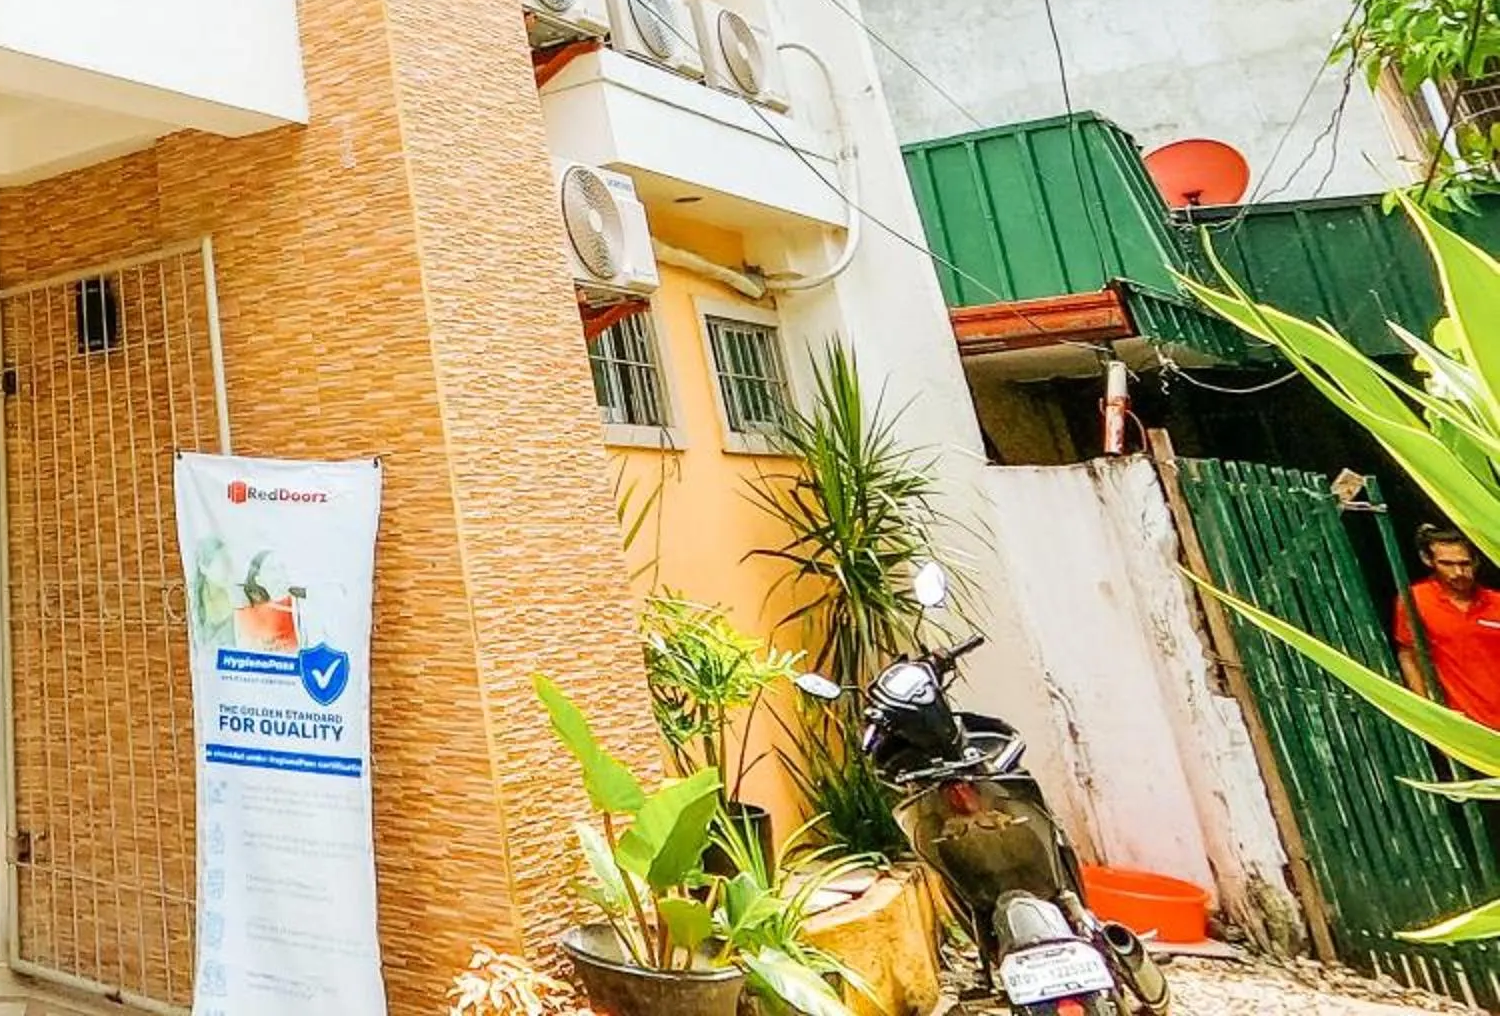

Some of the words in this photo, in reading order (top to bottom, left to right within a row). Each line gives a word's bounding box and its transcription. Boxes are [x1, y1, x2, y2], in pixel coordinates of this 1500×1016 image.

[247, 486, 327, 503] RedDoorz
[218, 703, 239, 714] THE
[240, 706, 283, 719] GOLDEN
[285, 709, 343, 724] STANDARD
[219, 715, 255, 734] FOR
[259, 719, 344, 742] QUALITY
